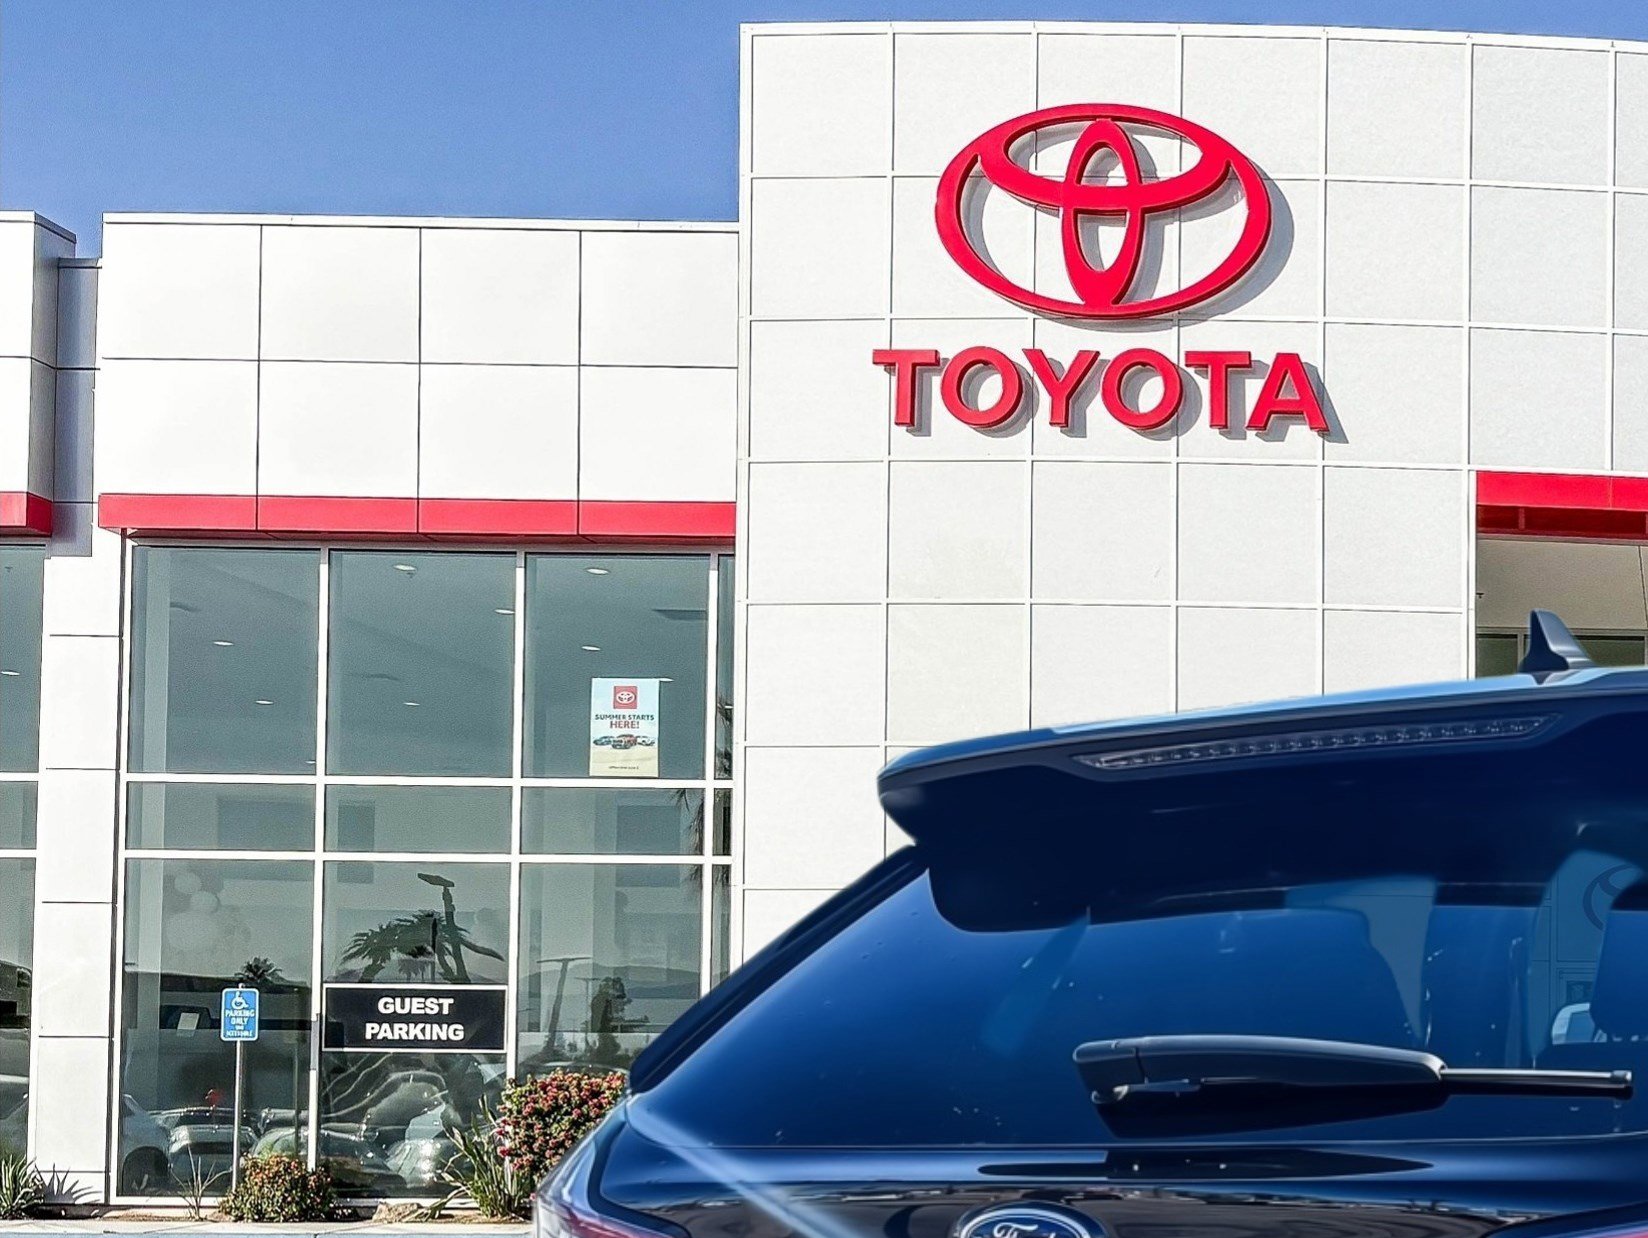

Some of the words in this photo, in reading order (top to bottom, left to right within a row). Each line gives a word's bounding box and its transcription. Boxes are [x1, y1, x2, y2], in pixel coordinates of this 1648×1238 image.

[872, 346, 1331, 436] TOYOTA
[609, 721, 640, 729] HERE!
[225, 1009, 255, 1018] PARKING
[378, 997, 454, 1015] GUEST
[365, 1023, 464, 1041] PARKING
